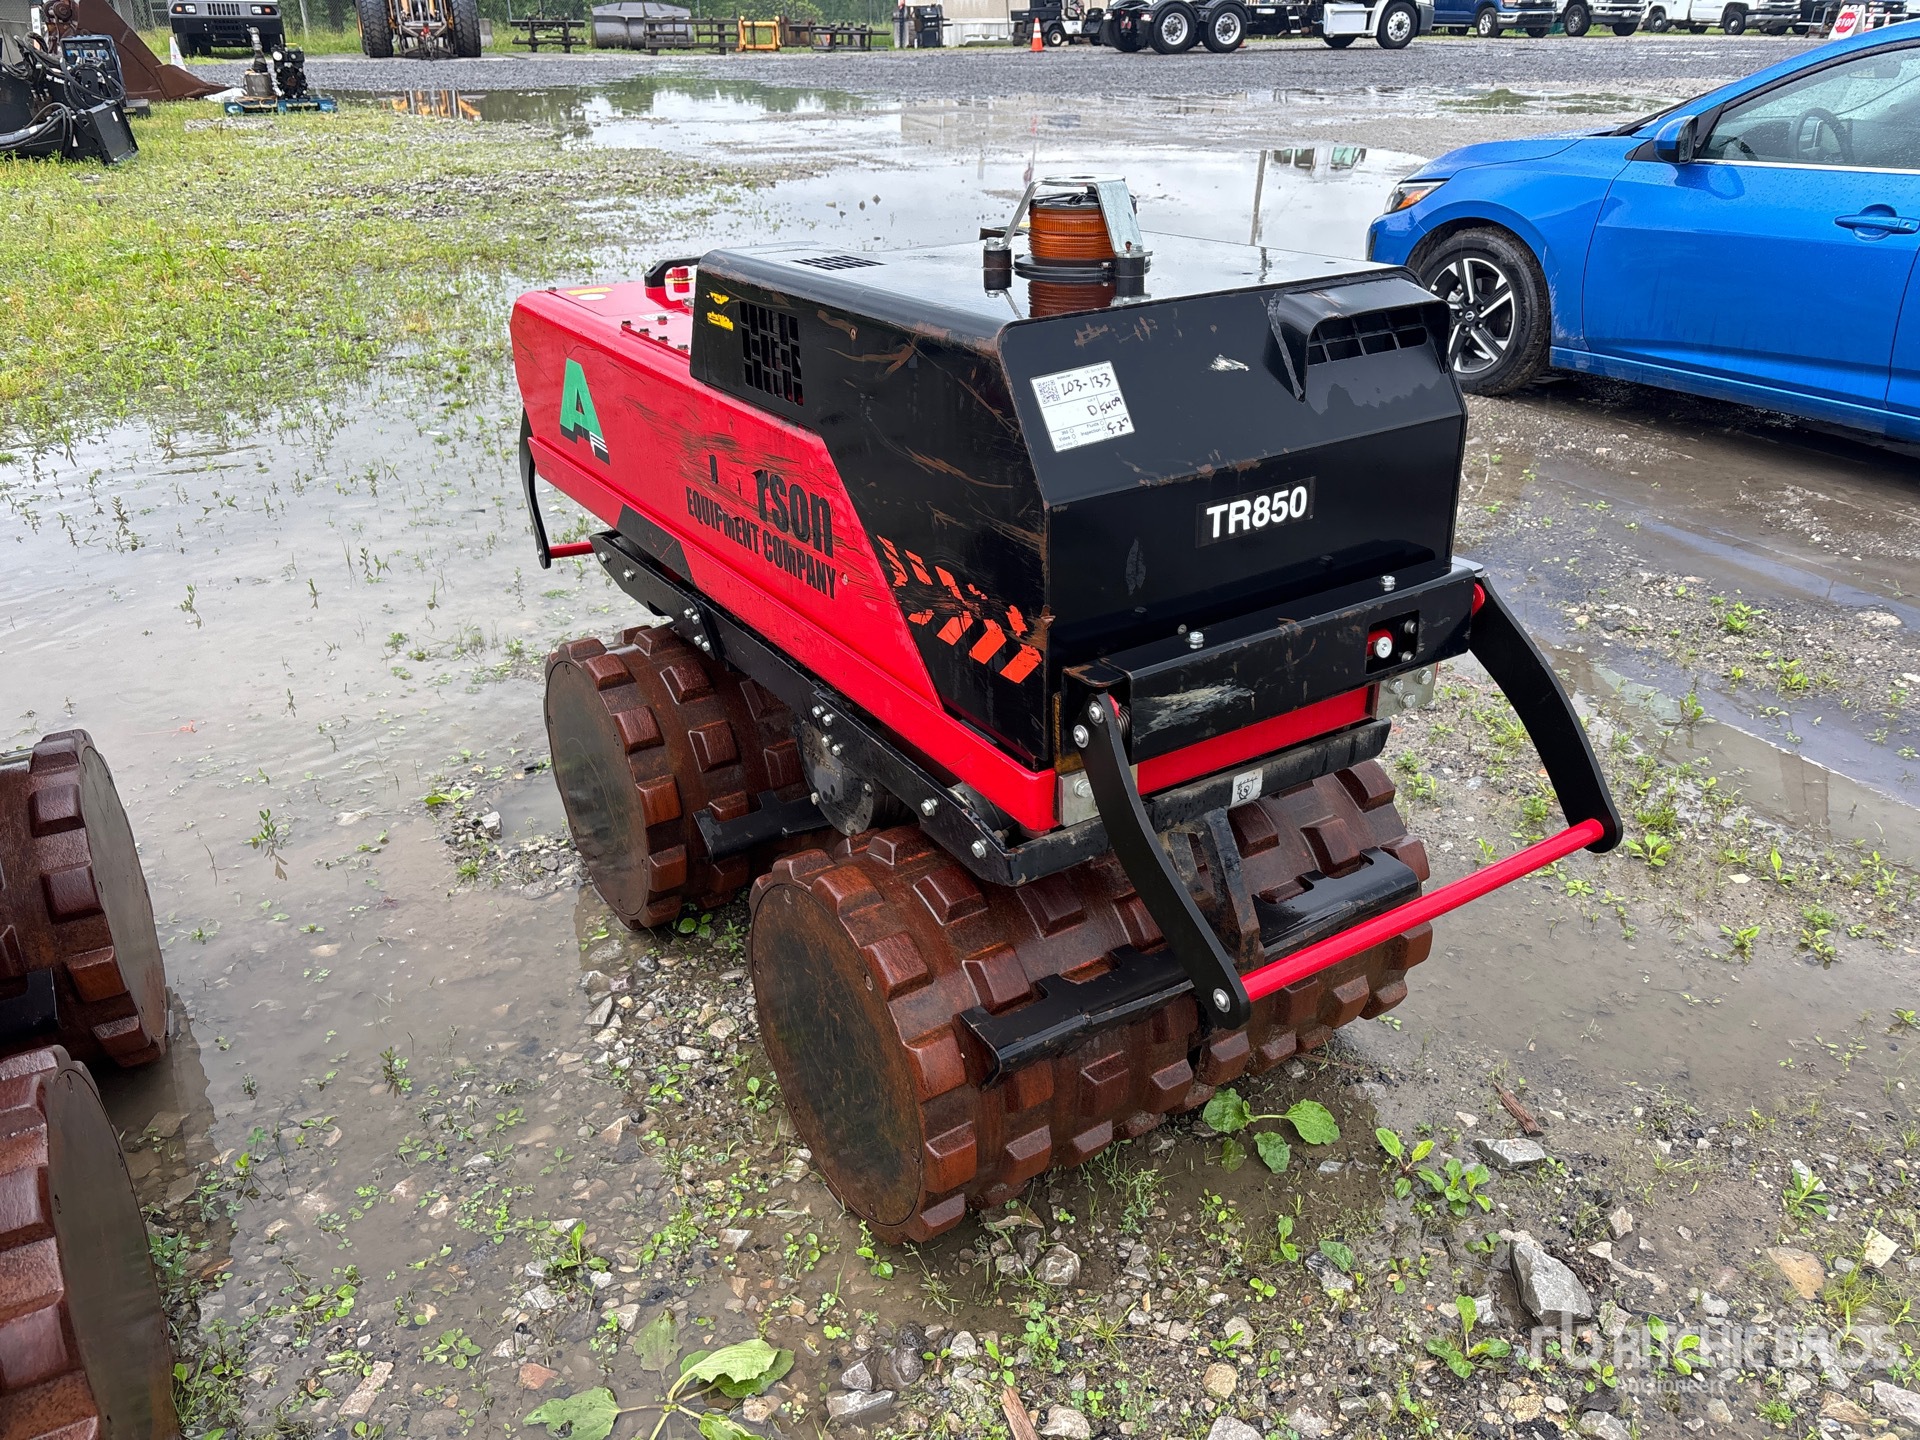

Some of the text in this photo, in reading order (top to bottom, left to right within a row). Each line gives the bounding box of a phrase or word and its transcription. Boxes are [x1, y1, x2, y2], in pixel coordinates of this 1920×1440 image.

[1835, 18, 1856, 27] STOP
[560, 358, 610, 465] A
[1206, 485, 1308, 538] TR850
